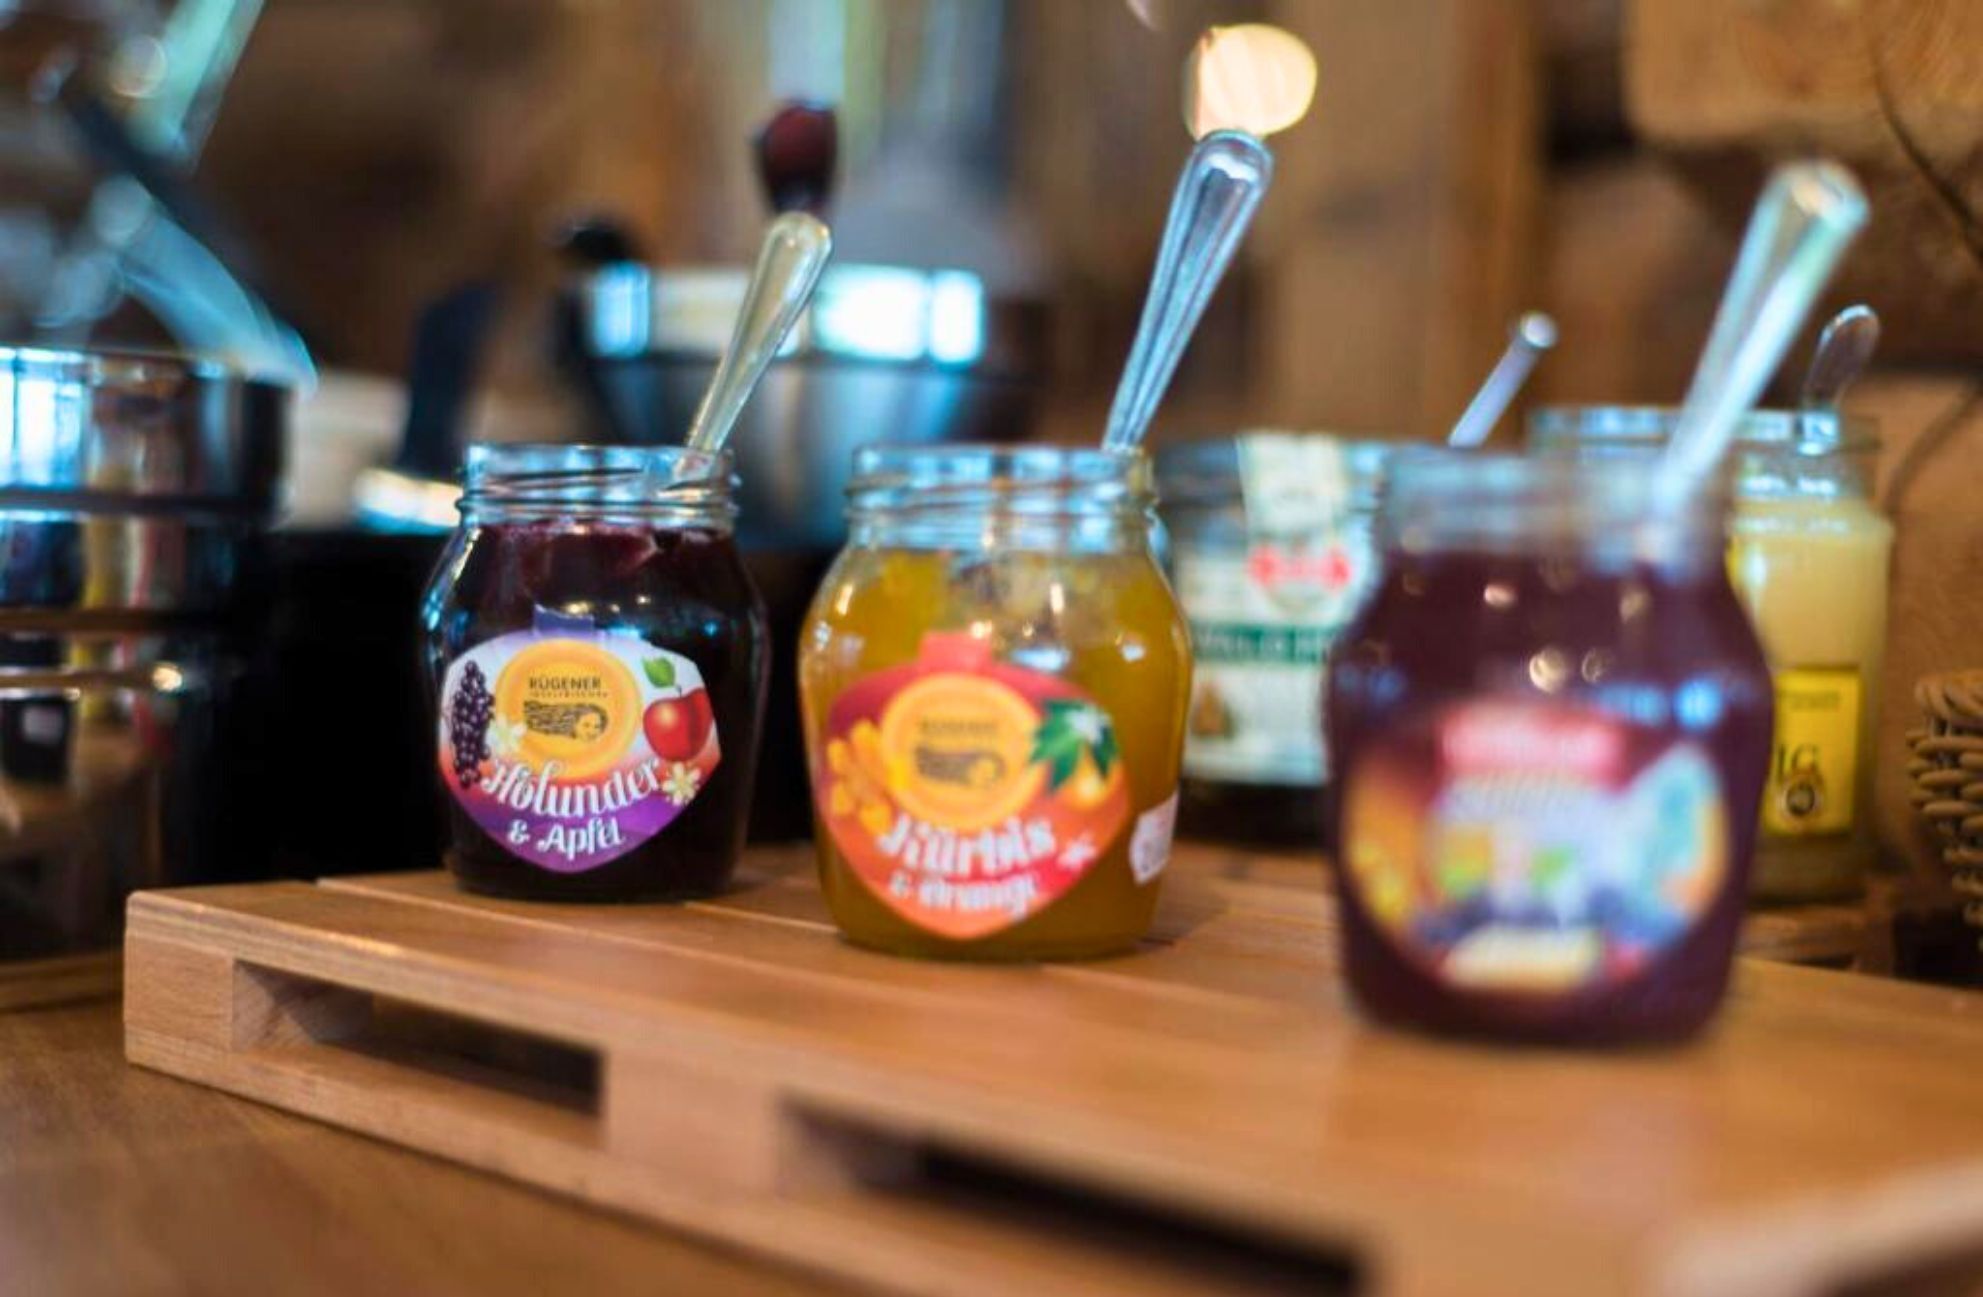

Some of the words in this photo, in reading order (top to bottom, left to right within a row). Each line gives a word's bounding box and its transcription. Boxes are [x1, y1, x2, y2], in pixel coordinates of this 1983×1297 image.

[529, 674, 602, 690] RÜGENER
[480, 757, 660, 818] Holunder
[507, 818, 531, 845] &
[536, 815, 627, 862] Apfel
